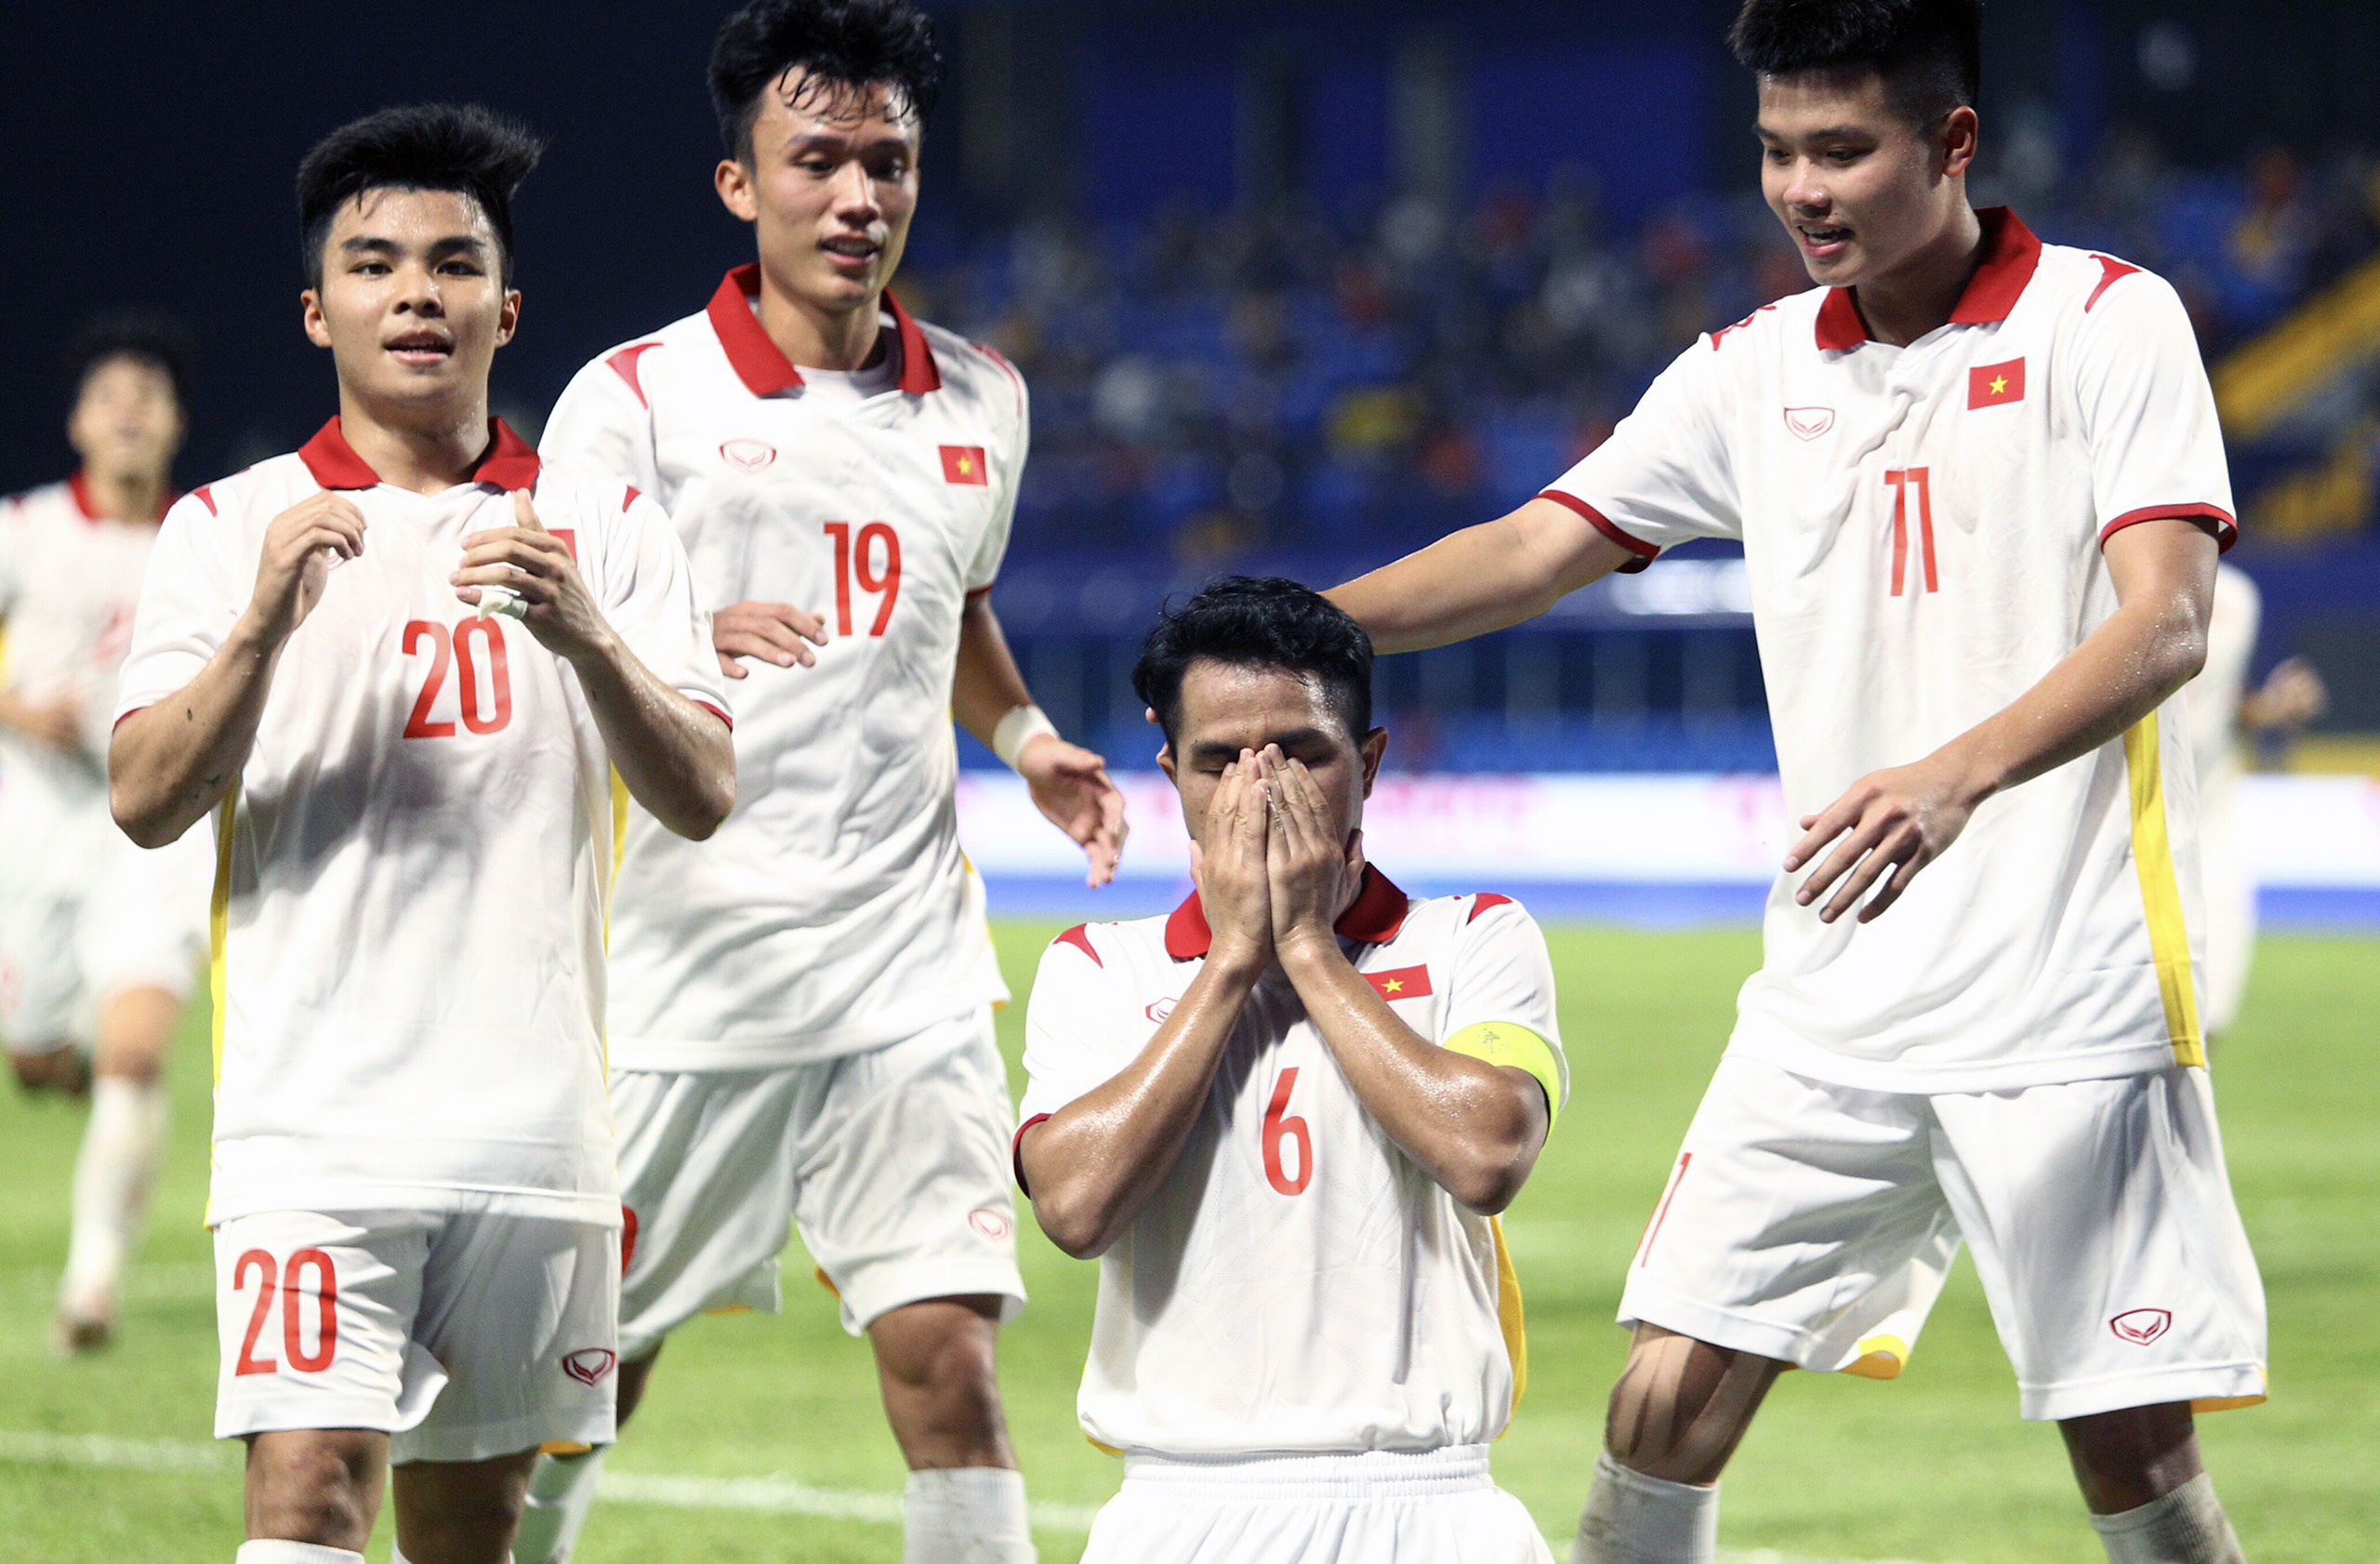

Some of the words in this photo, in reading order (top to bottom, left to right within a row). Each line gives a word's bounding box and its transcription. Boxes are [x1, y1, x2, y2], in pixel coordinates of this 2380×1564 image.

[824, 521, 902, 638] 19
[1884, 467, 1938, 597] 11
[402, 616, 512, 739] 20
[1262, 1067, 1313, 1196] 6
[233, 1247, 337, 1377] 20
